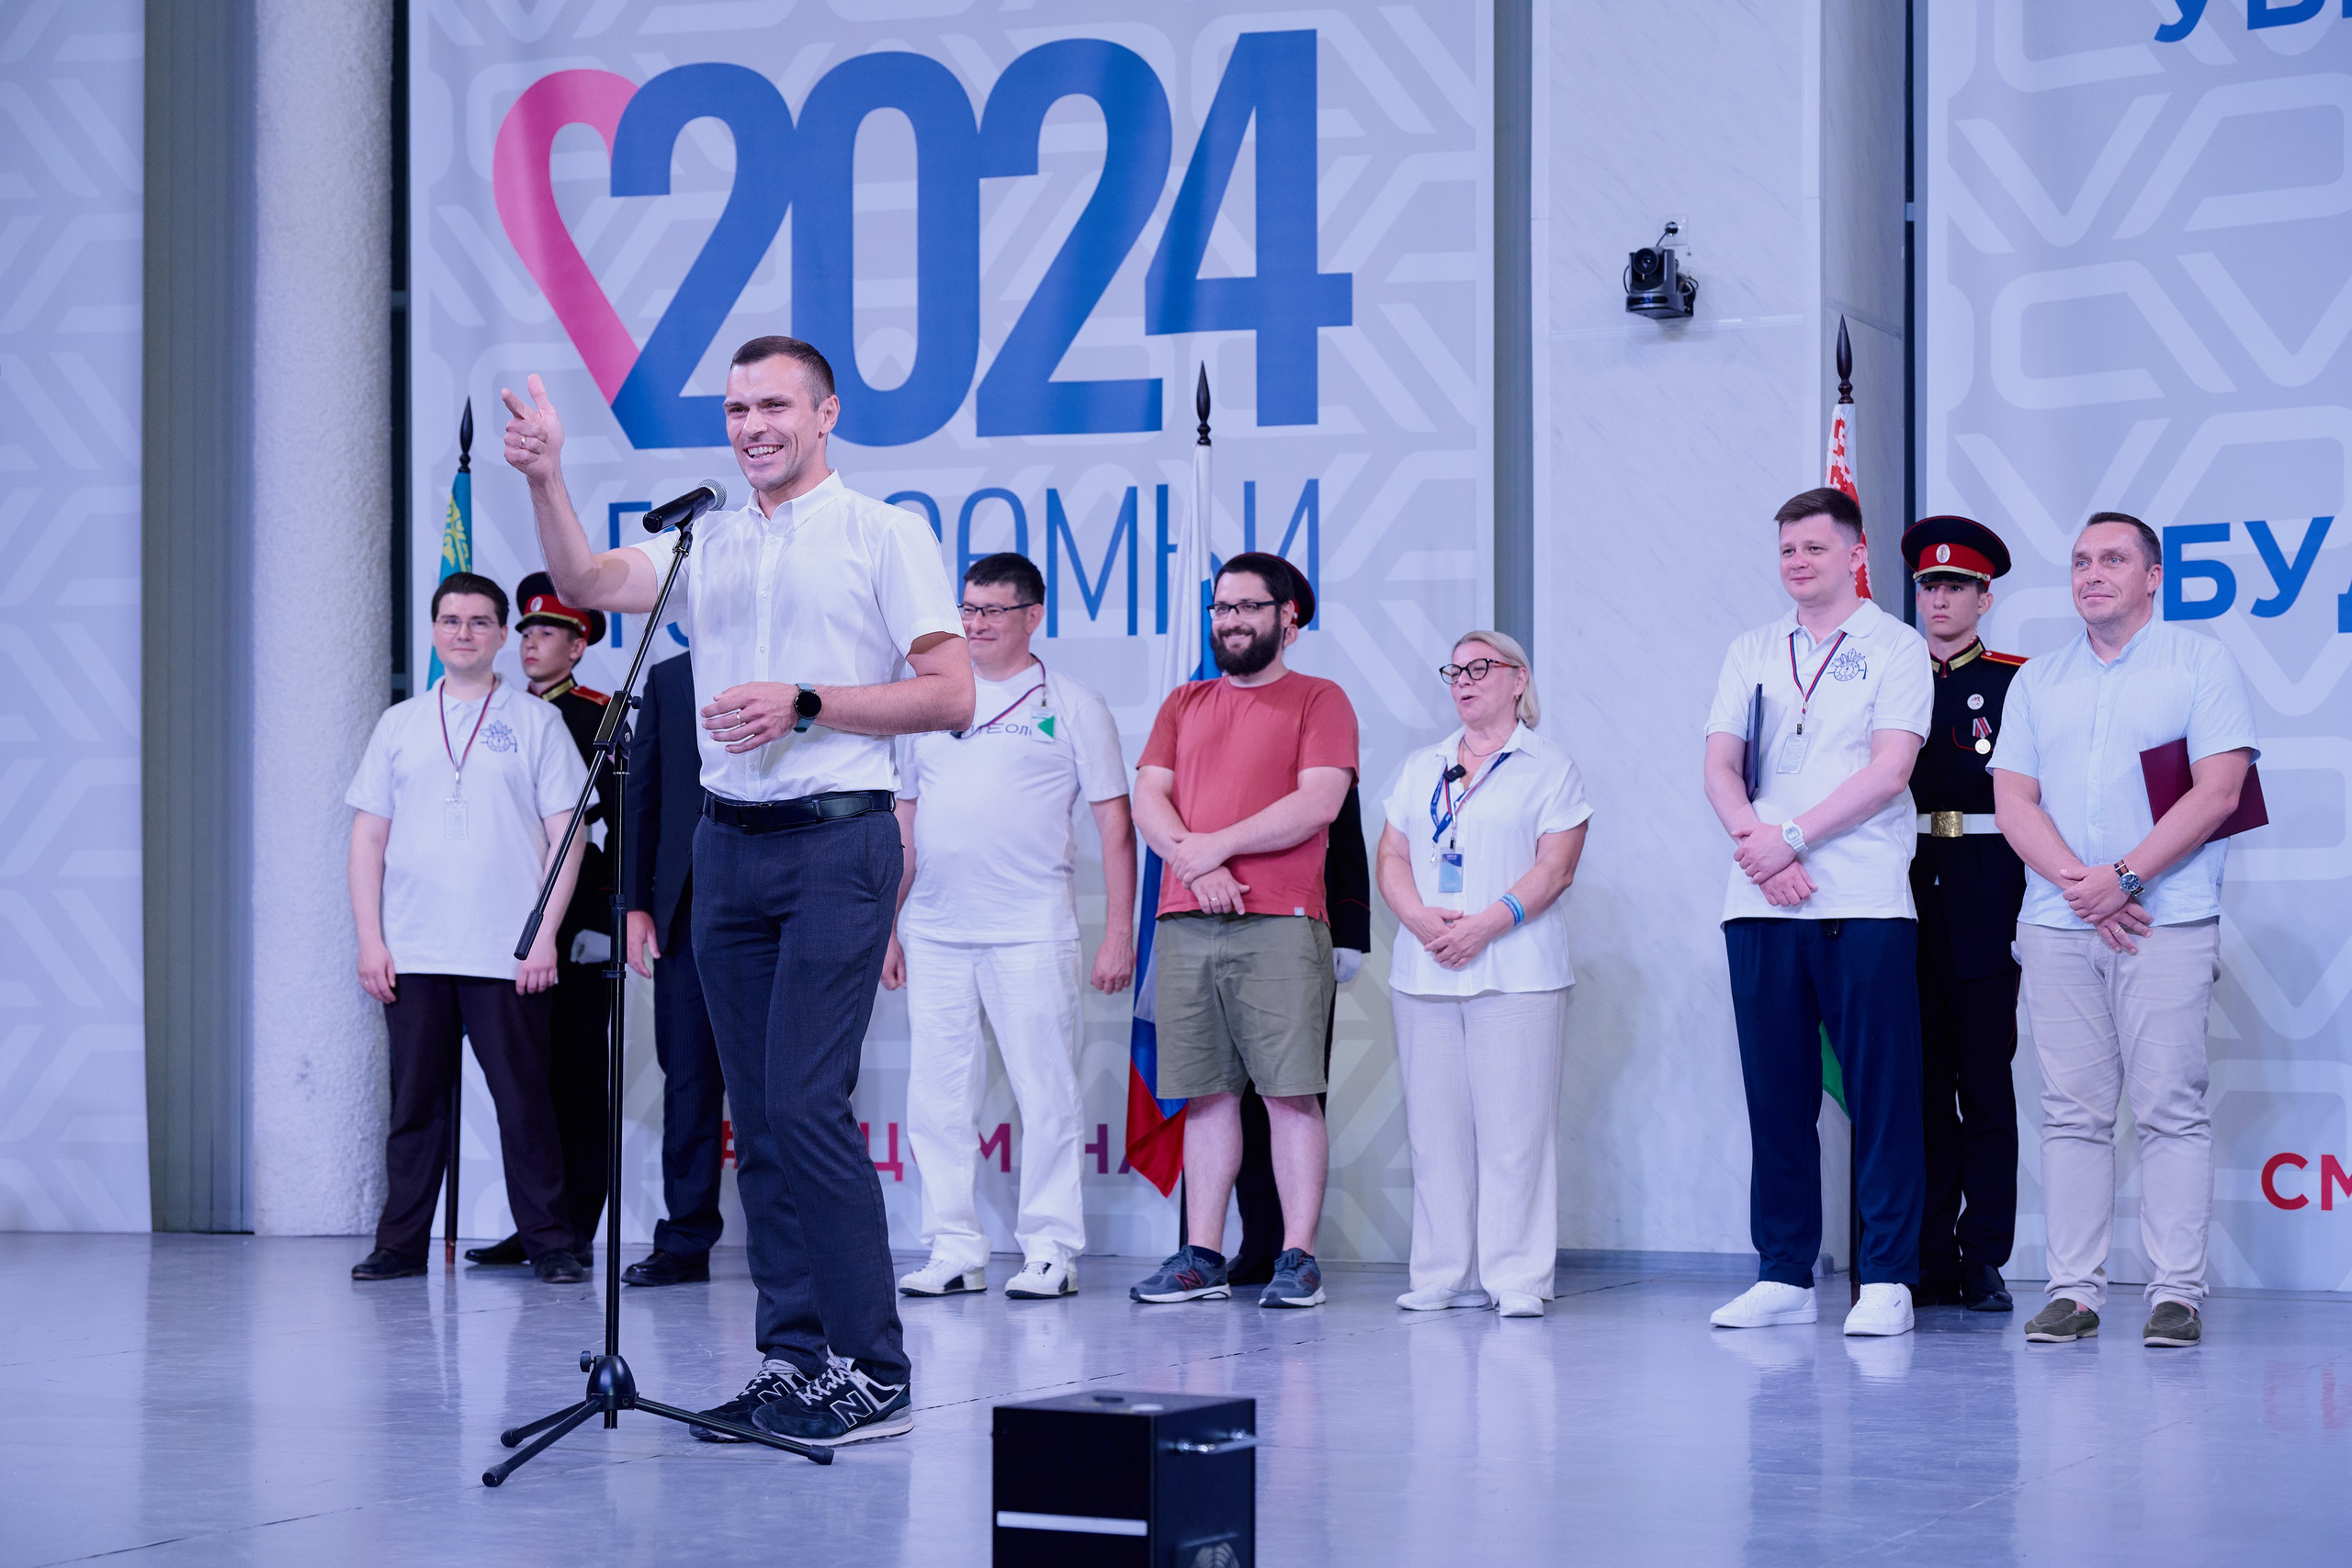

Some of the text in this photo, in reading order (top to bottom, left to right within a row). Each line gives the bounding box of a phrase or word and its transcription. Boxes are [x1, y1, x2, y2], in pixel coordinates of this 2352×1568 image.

[610, 29, 1352, 449] 2024
[2163, 516, 2352, 634] БУ
[830, 1391, 874, 1428] N
